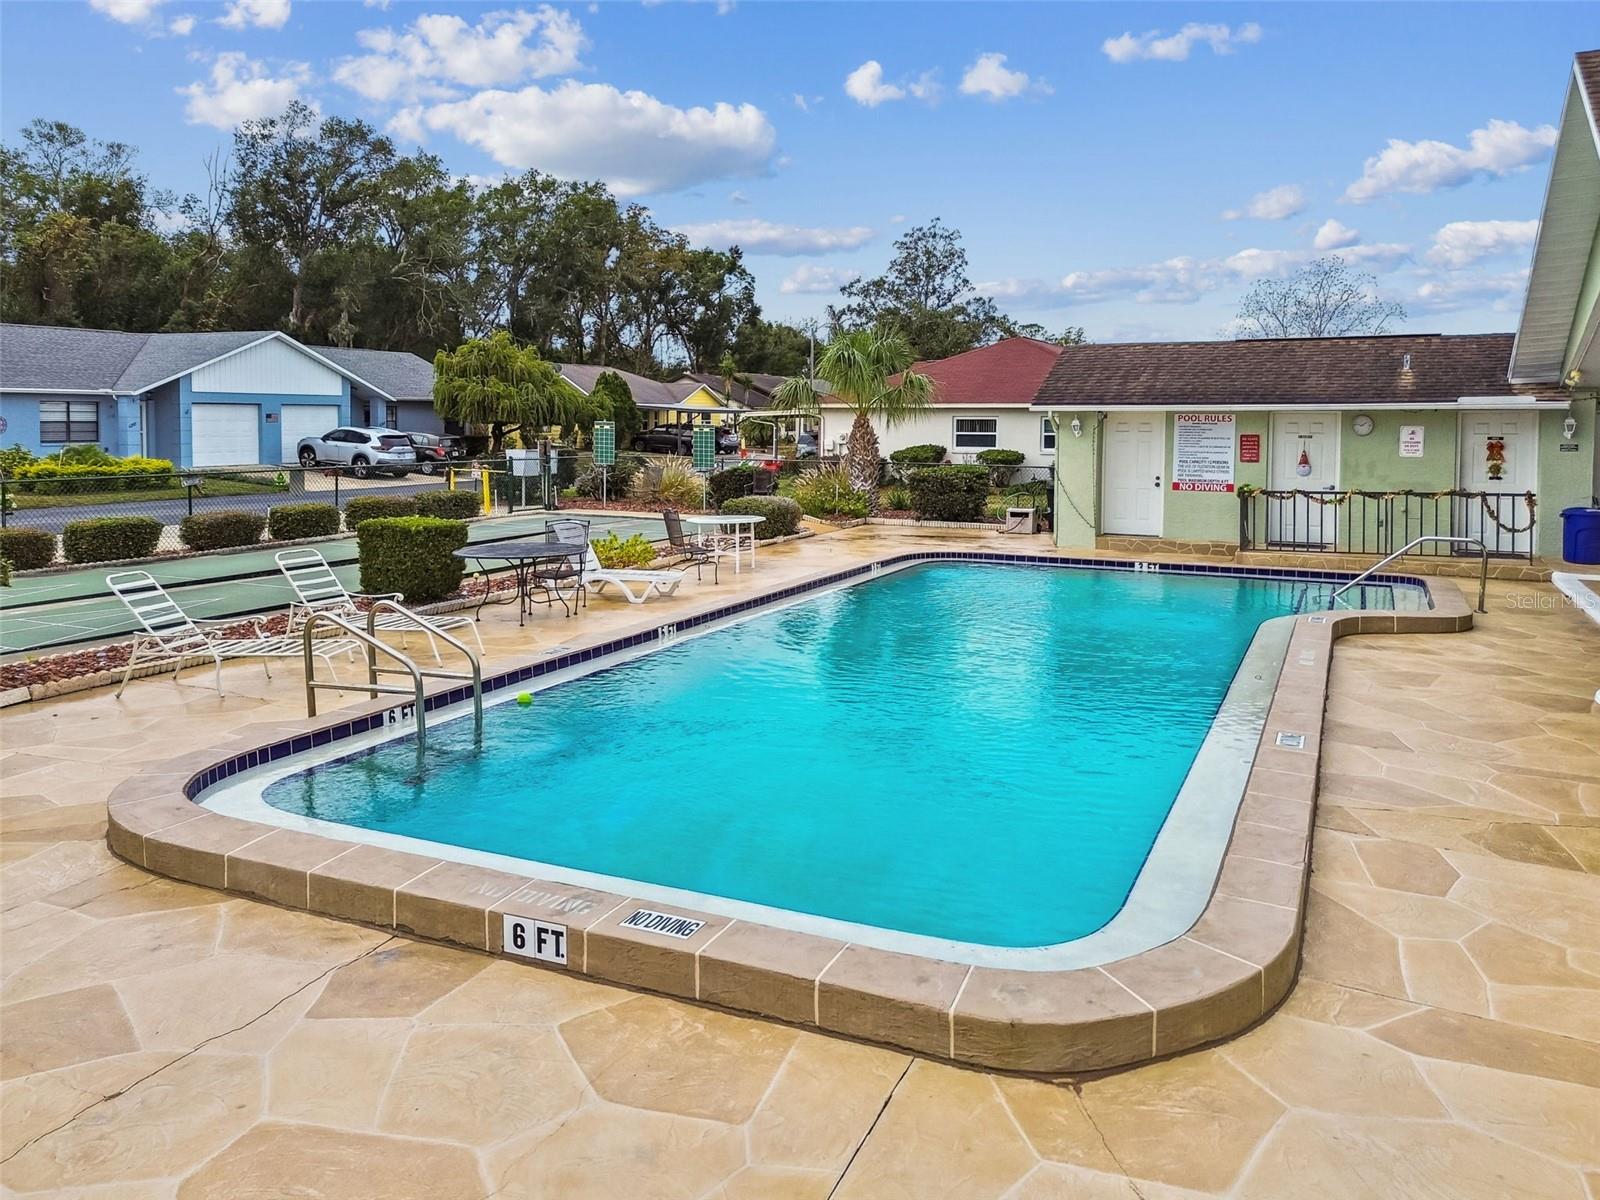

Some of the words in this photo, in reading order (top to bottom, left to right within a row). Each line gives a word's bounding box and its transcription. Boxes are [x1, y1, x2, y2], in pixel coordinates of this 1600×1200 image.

[1178, 414, 1202, 422] POOL
[1204, 414, 1233, 423] RULES
[1179, 482, 1193, 490] NO
[1194, 483, 1227, 492] DIVING
[388, 709, 396, 723] 6
[401, 702, 415, 719] FT
[623, 910, 652, 926] NO
[644, 914, 700, 937] DIVING
[512, 922, 525, 949] 6
[536, 926, 565, 958] FT.
